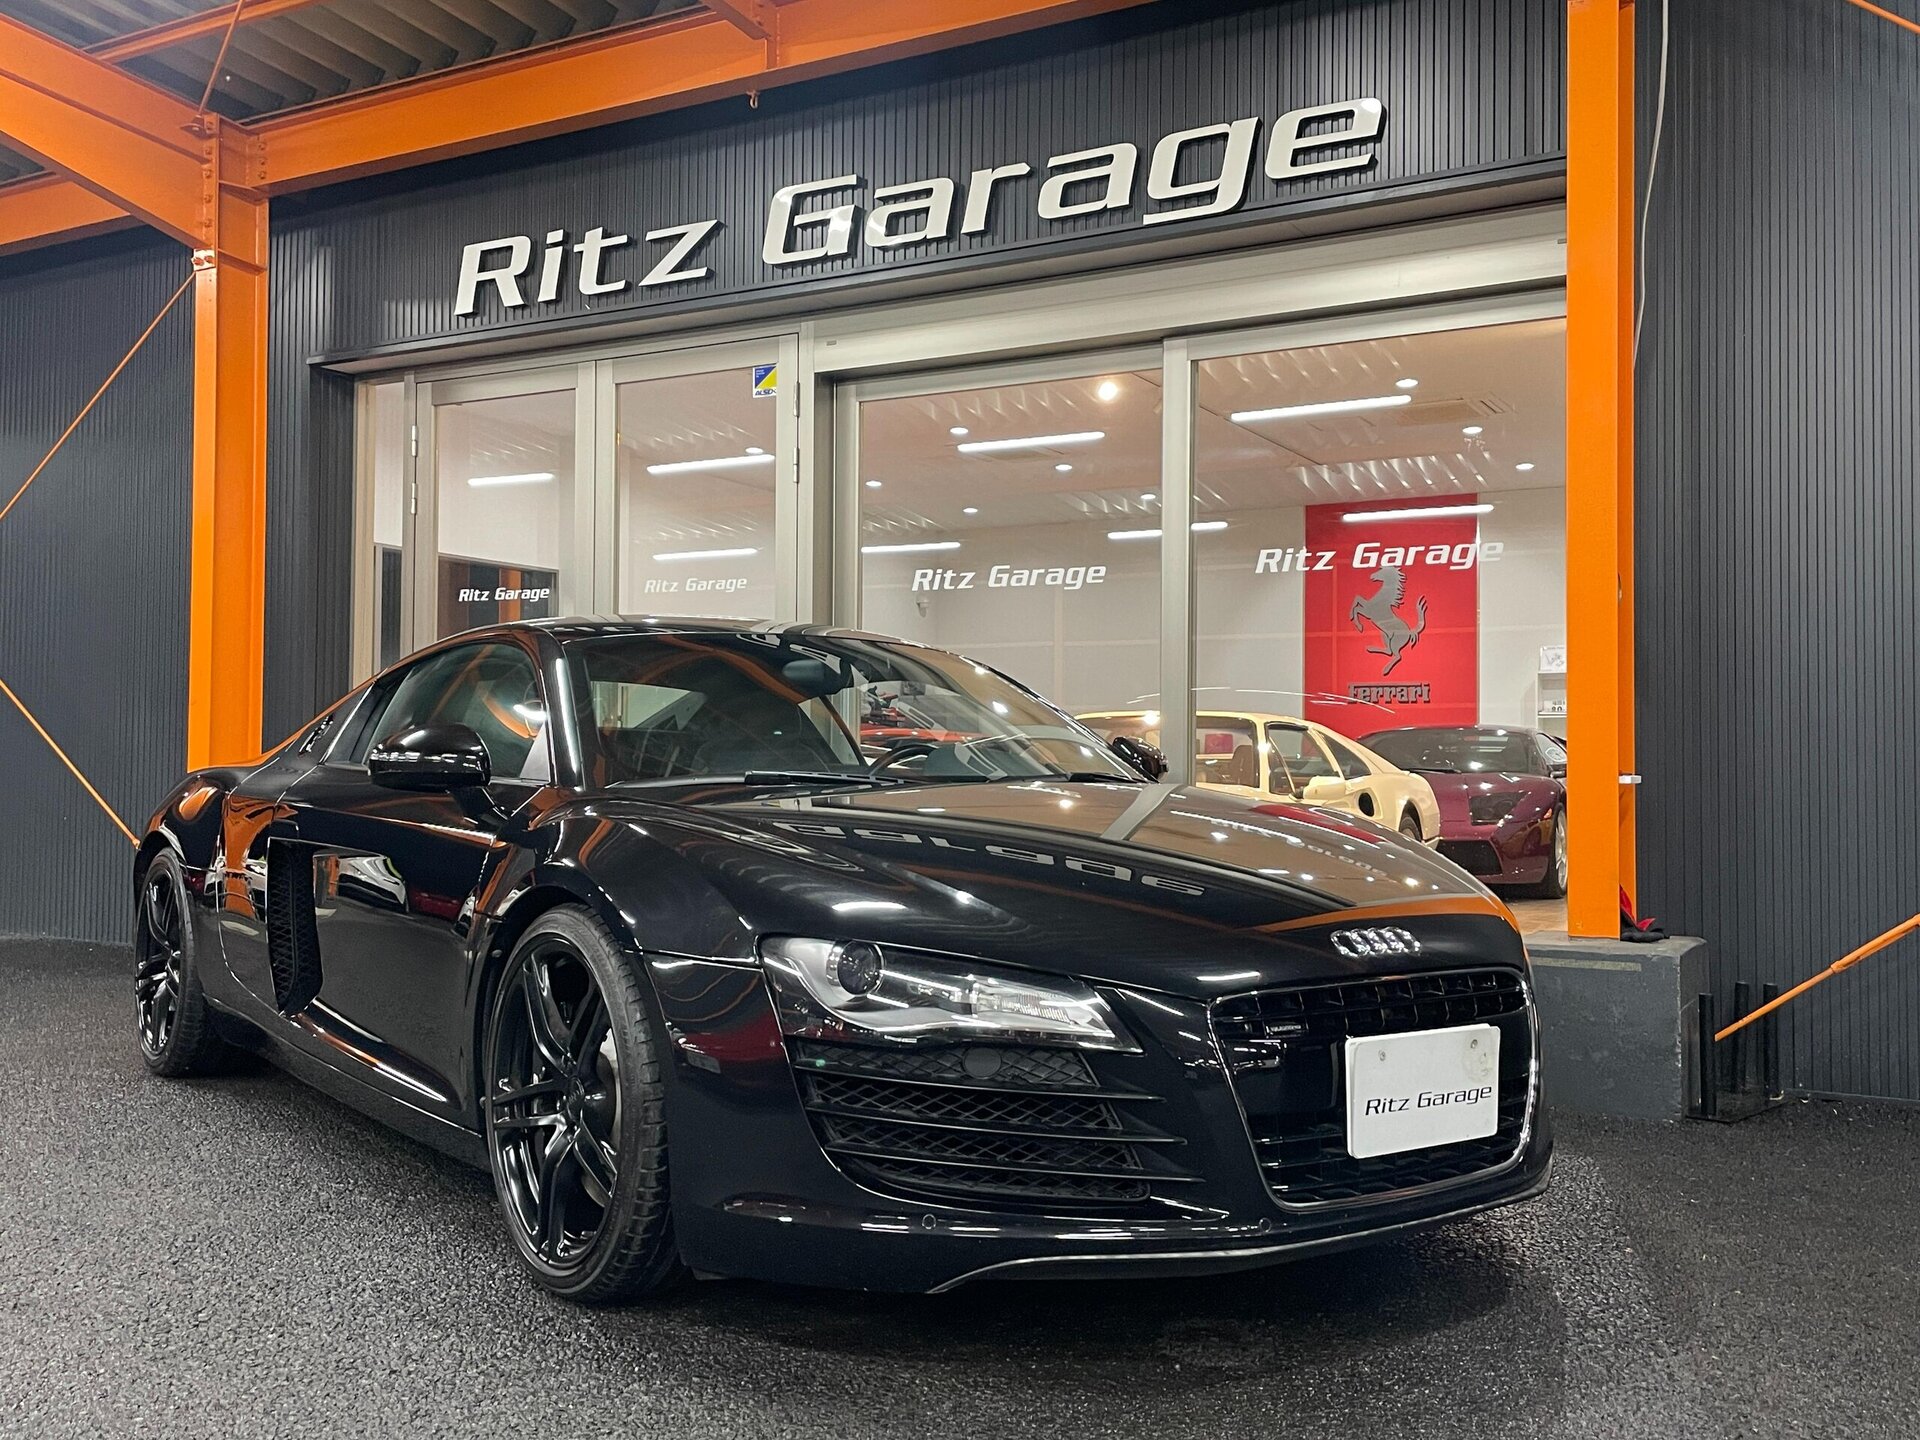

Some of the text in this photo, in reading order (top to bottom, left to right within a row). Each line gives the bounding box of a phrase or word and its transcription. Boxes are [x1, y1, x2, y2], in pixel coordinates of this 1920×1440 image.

[453, 97, 1383, 316] Ritz Garage
[1255, 541, 1504, 574] Ritz Garage
[644, 577, 748, 593] Ritz Garage
[911, 564, 1107, 591] Ritz Garage
[458, 587, 550, 602] Ritz Garage
[1348, 682, 1431, 704] Ferrari
[1365, 1086, 1492, 1116] Ritz Garage
